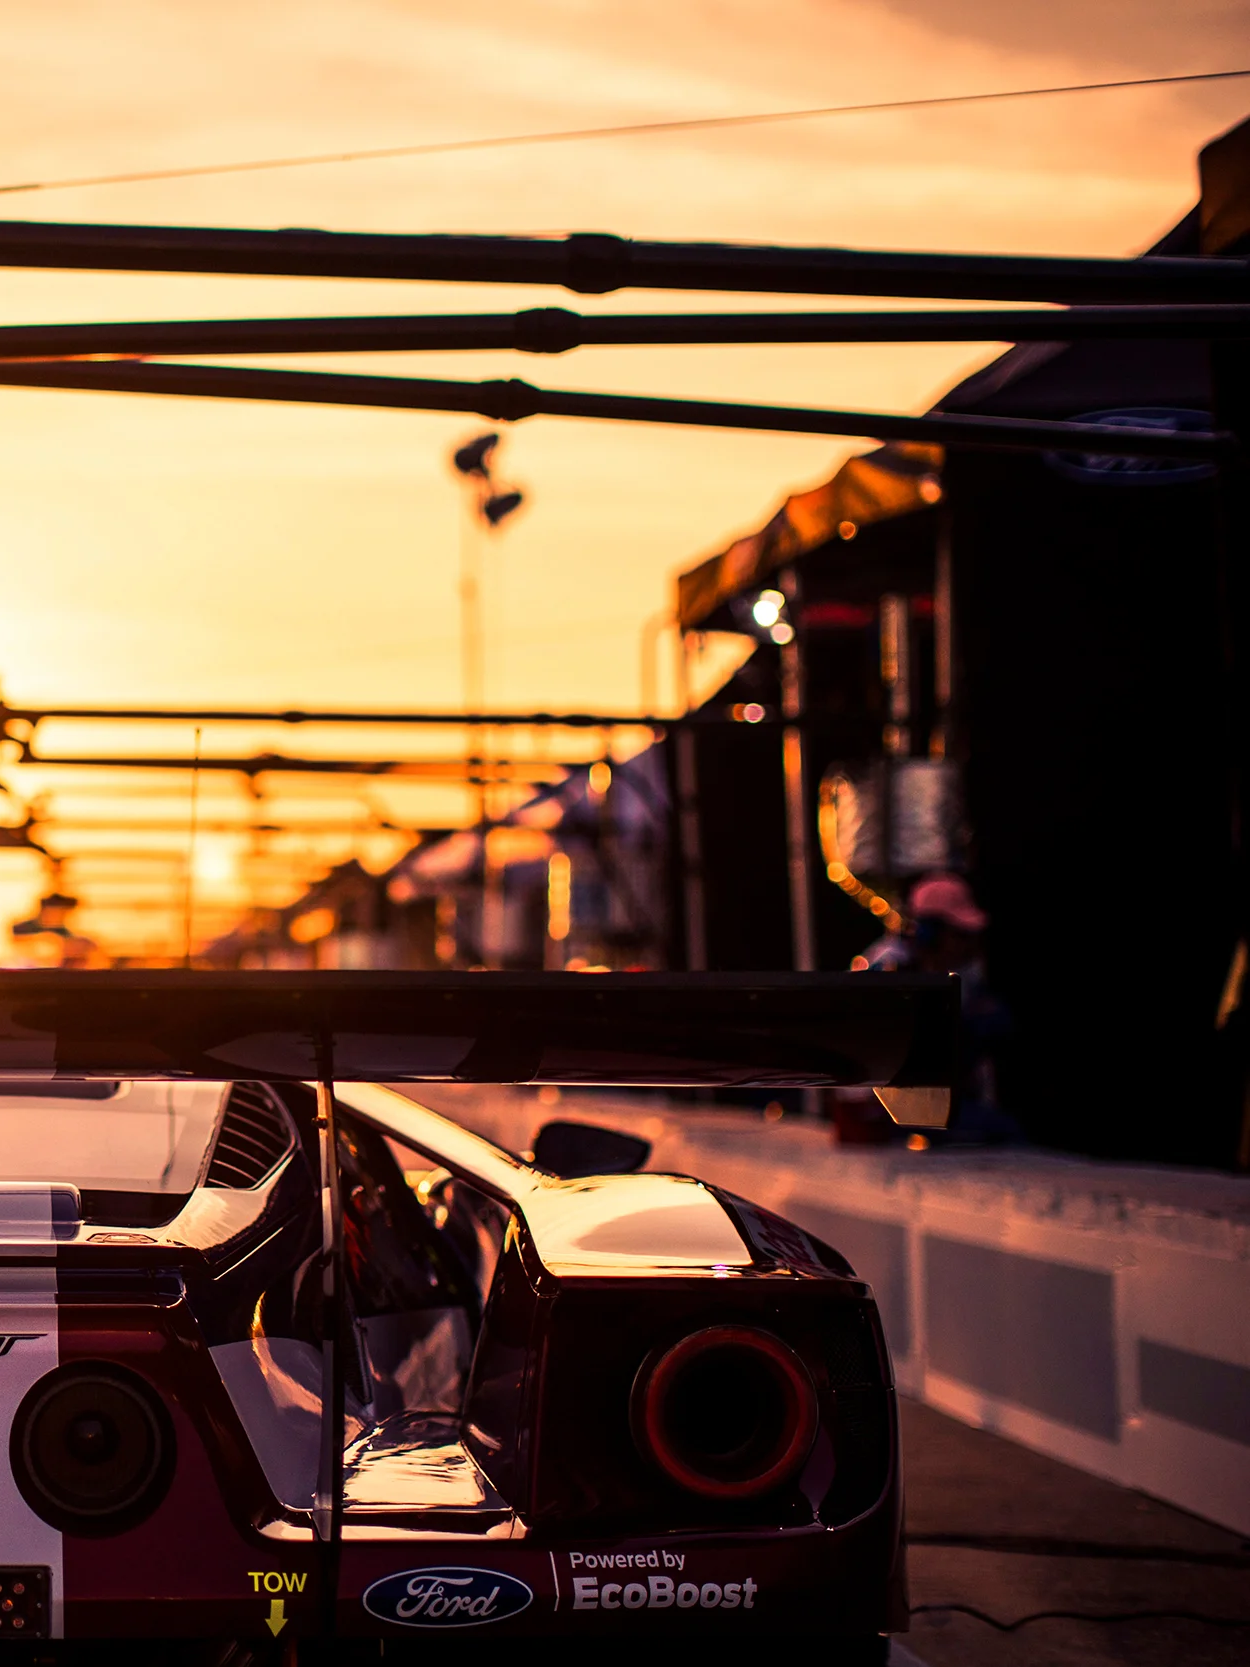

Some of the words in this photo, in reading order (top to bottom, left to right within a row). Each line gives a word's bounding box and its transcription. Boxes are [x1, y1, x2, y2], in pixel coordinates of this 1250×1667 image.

[569, 1551, 659, 1569] Powered
[663, 1550, 686, 1571] by
[247, 1571, 308, 1593] TOW
[572, 1576, 758, 1610] EcoBoost
[395, 1575, 501, 1618] Ford
